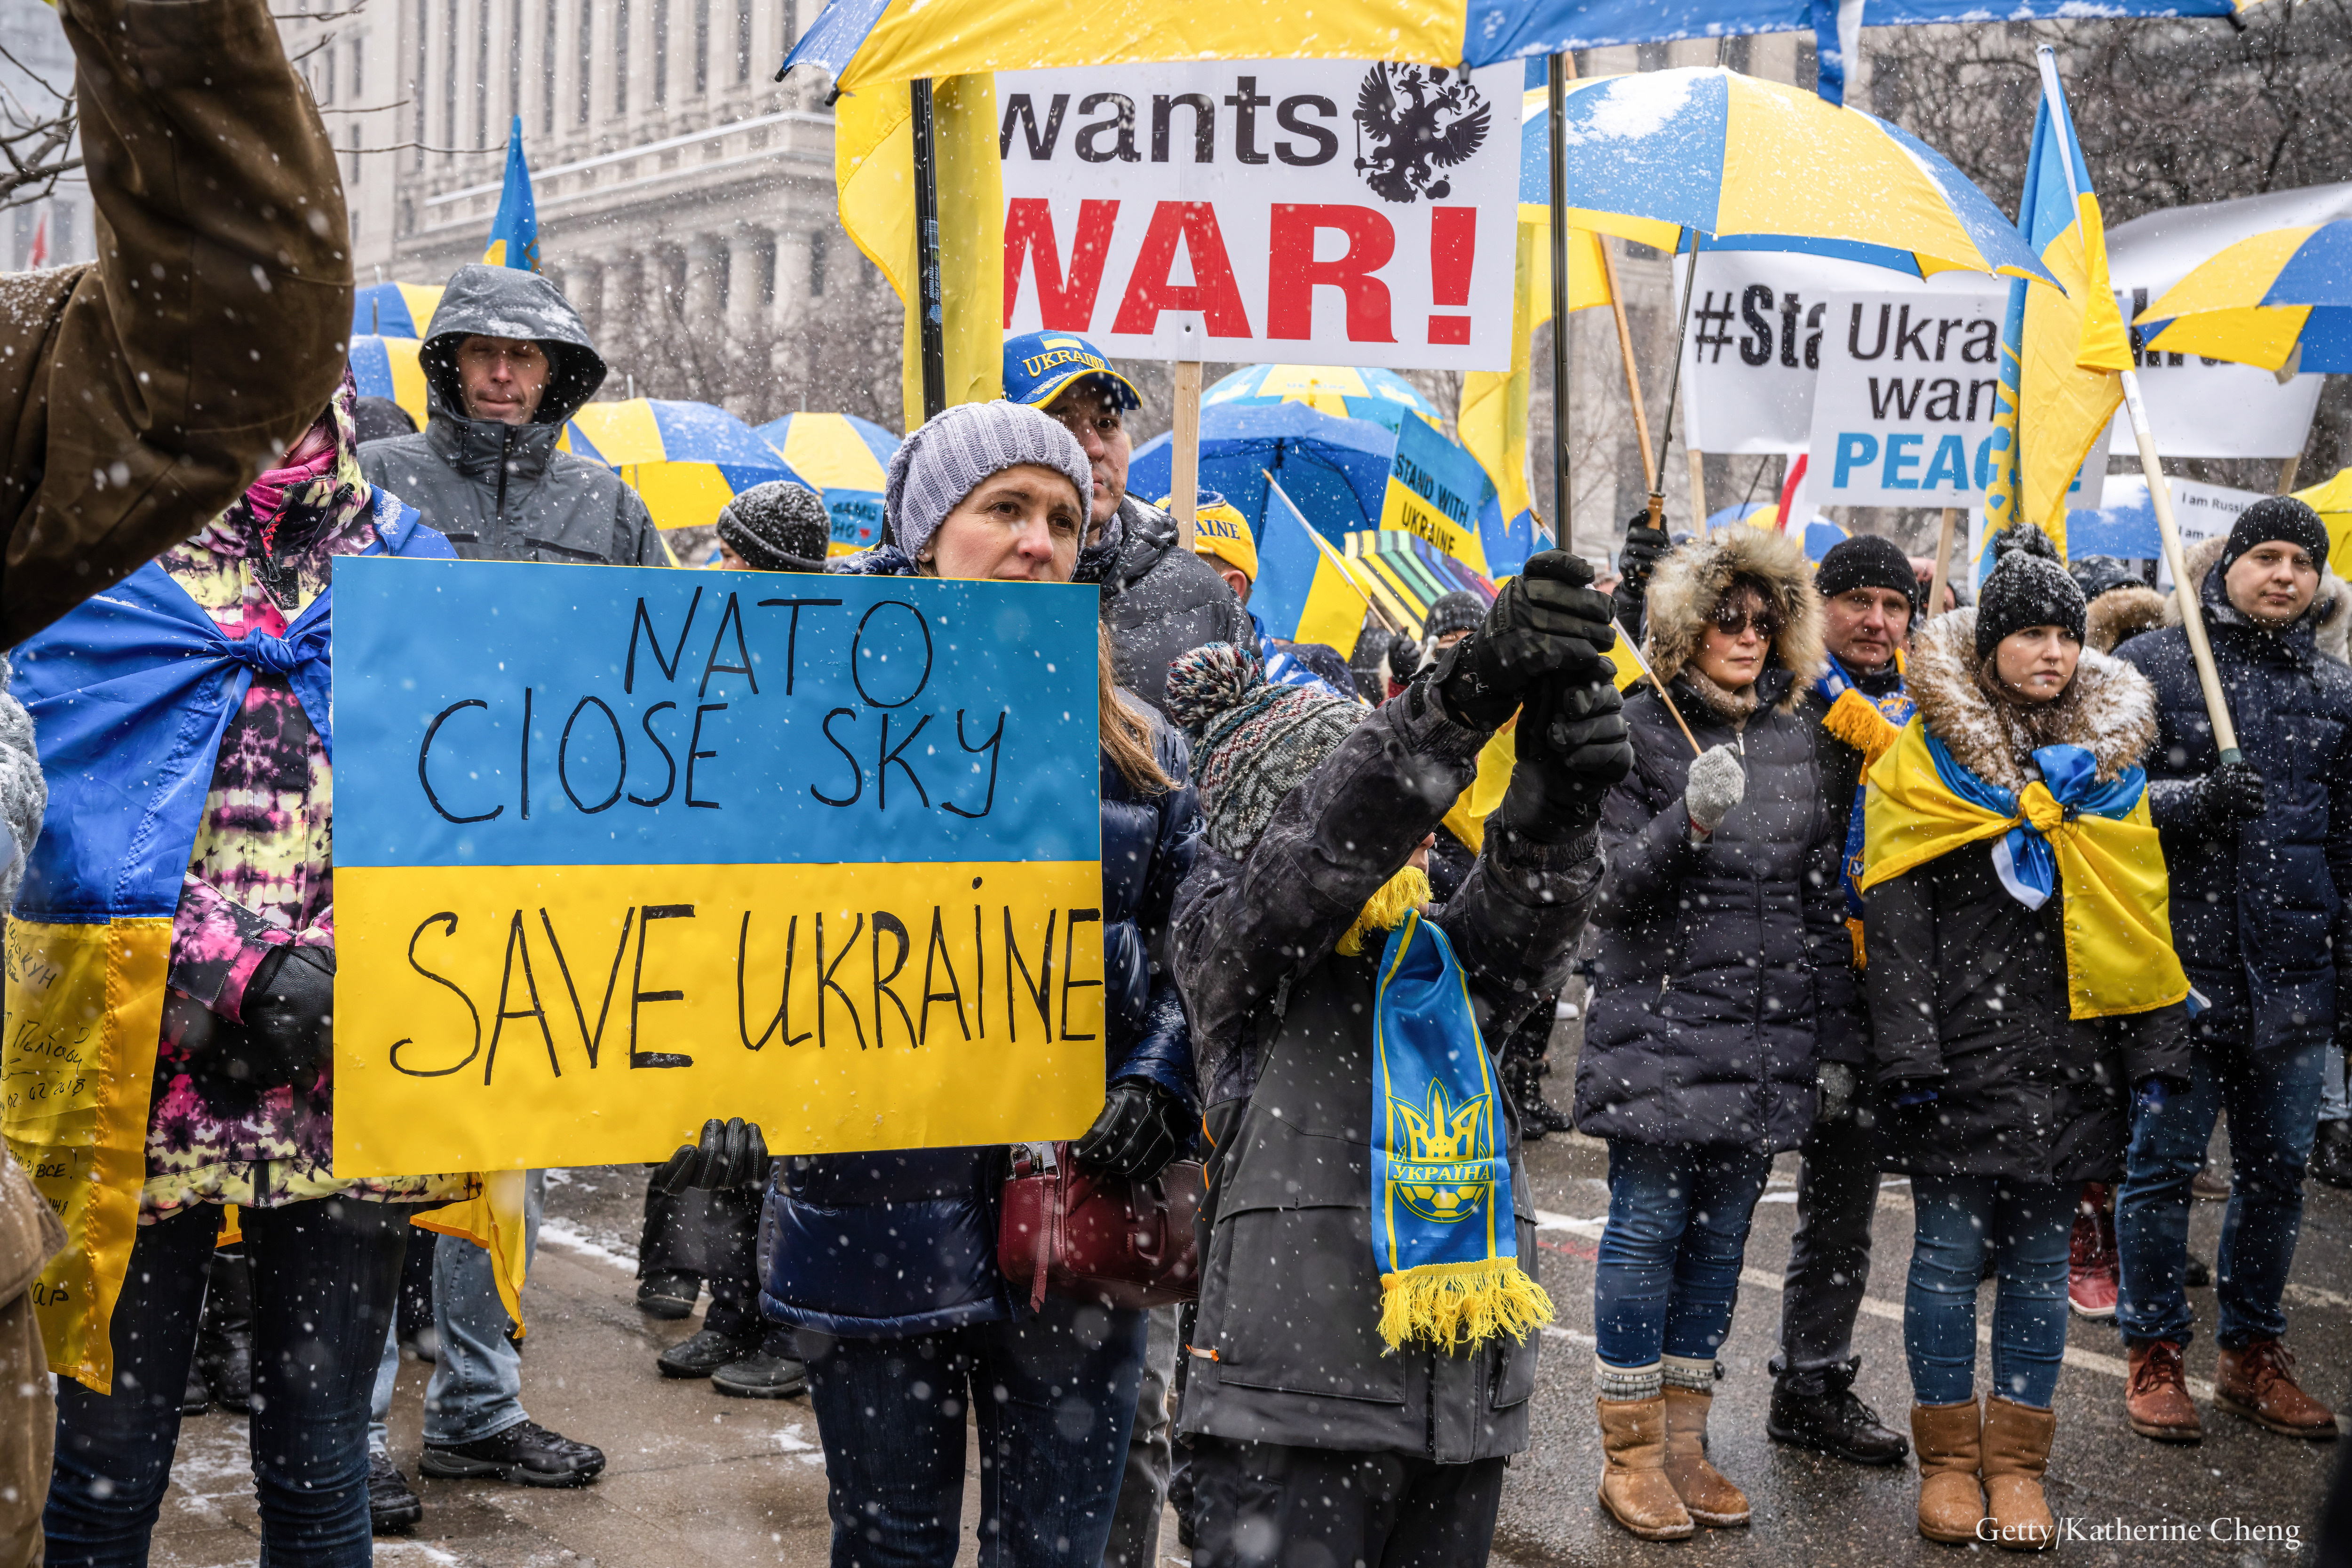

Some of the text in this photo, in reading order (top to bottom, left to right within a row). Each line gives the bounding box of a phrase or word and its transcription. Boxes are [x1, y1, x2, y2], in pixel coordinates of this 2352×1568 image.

[1000, 76, 1338, 166] wants
[1003, 198, 1477, 345] WAR!
[1023, 350, 1105, 378] UKRAINE
[1395, 453, 1469, 527] STAND WITH
[2189, 497, 2209, 507] am
[2212, 498, 2248, 513] Russi
[1196, 520, 1240, 540] AINE
[1402, 501, 1455, 557] UKRAINE
[625, 586, 933, 708] NATO
[389, 904, 696, 1086] SAVE
[1393, 1164, 1490, 1181] УКРАЇНА
